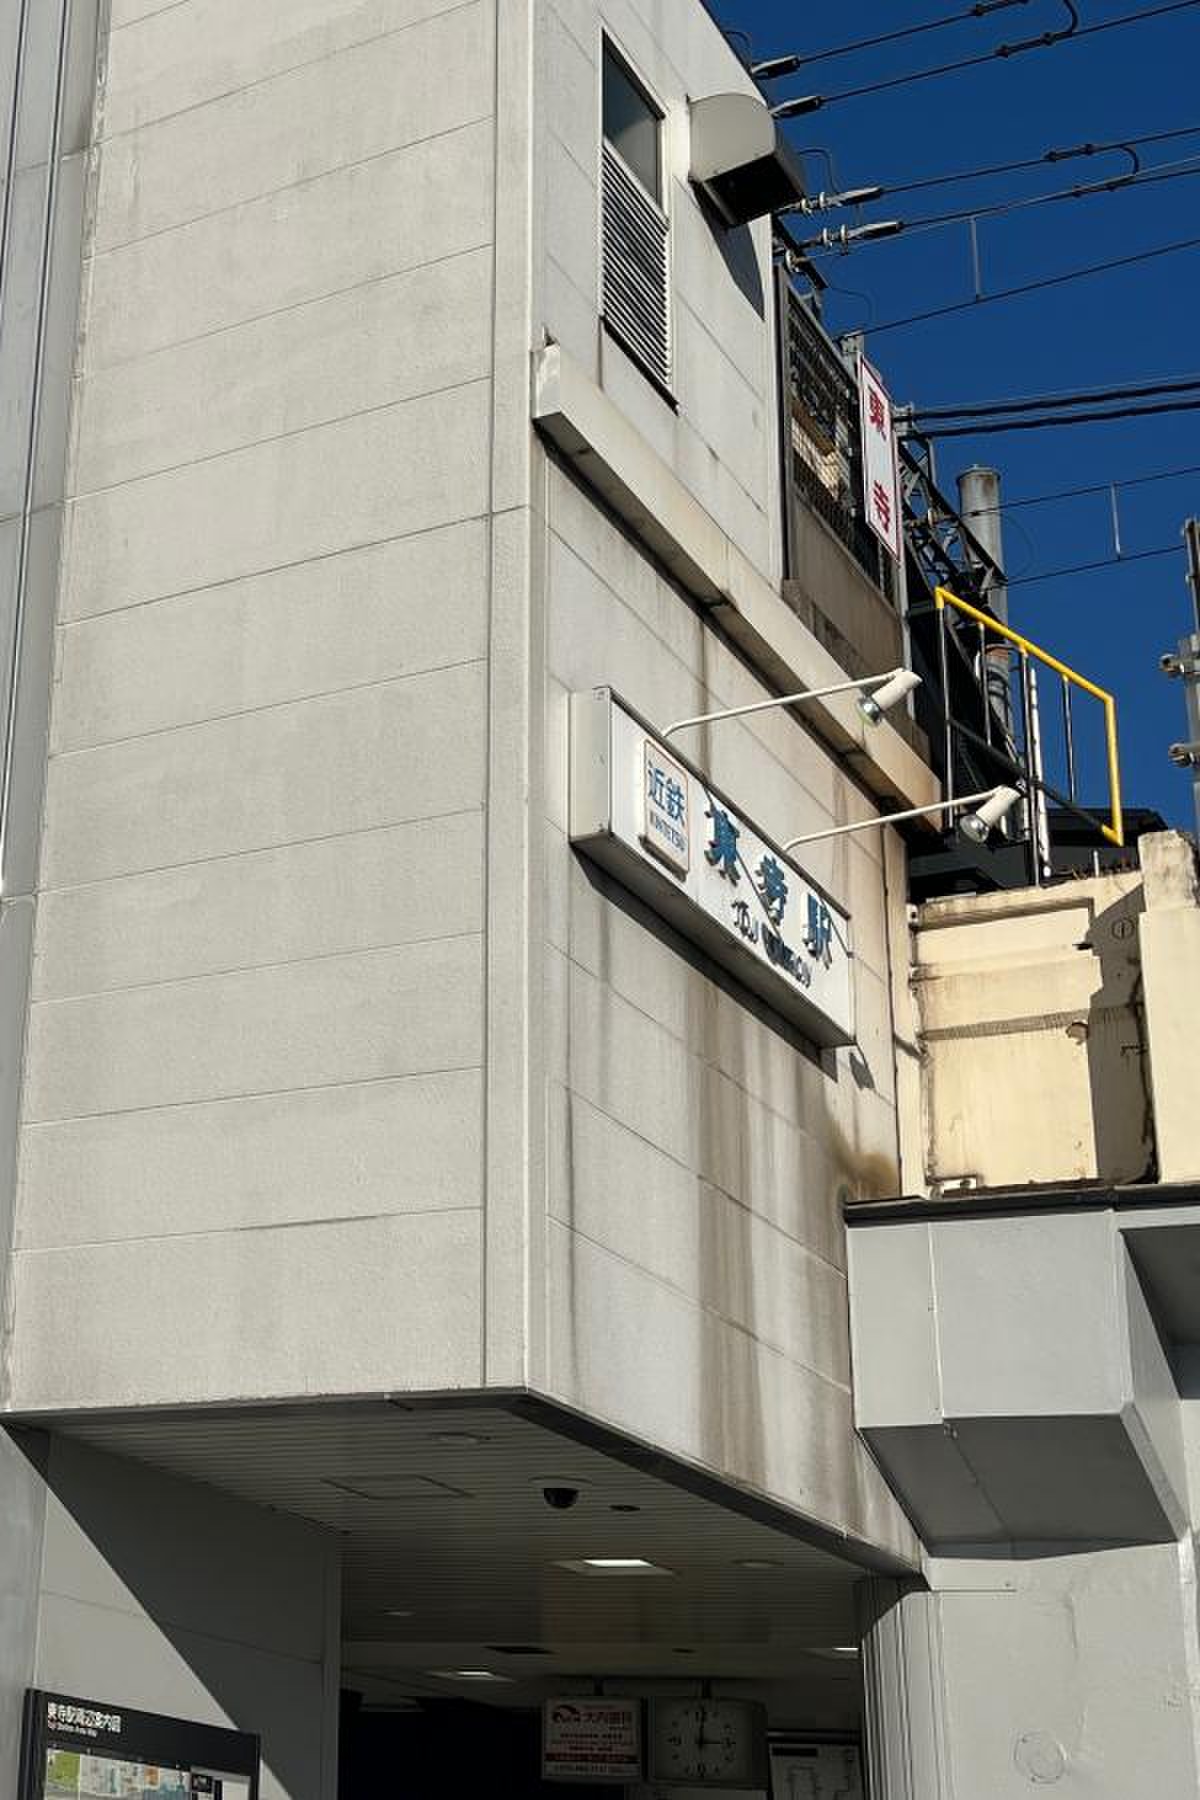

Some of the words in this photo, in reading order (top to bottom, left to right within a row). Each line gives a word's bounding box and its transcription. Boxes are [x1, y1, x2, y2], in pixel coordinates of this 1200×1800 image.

[868, 384, 890, 534] 東寺
[648, 766, 686, 826] 近鉄
[704, 802, 833, 970] 東寺駅
